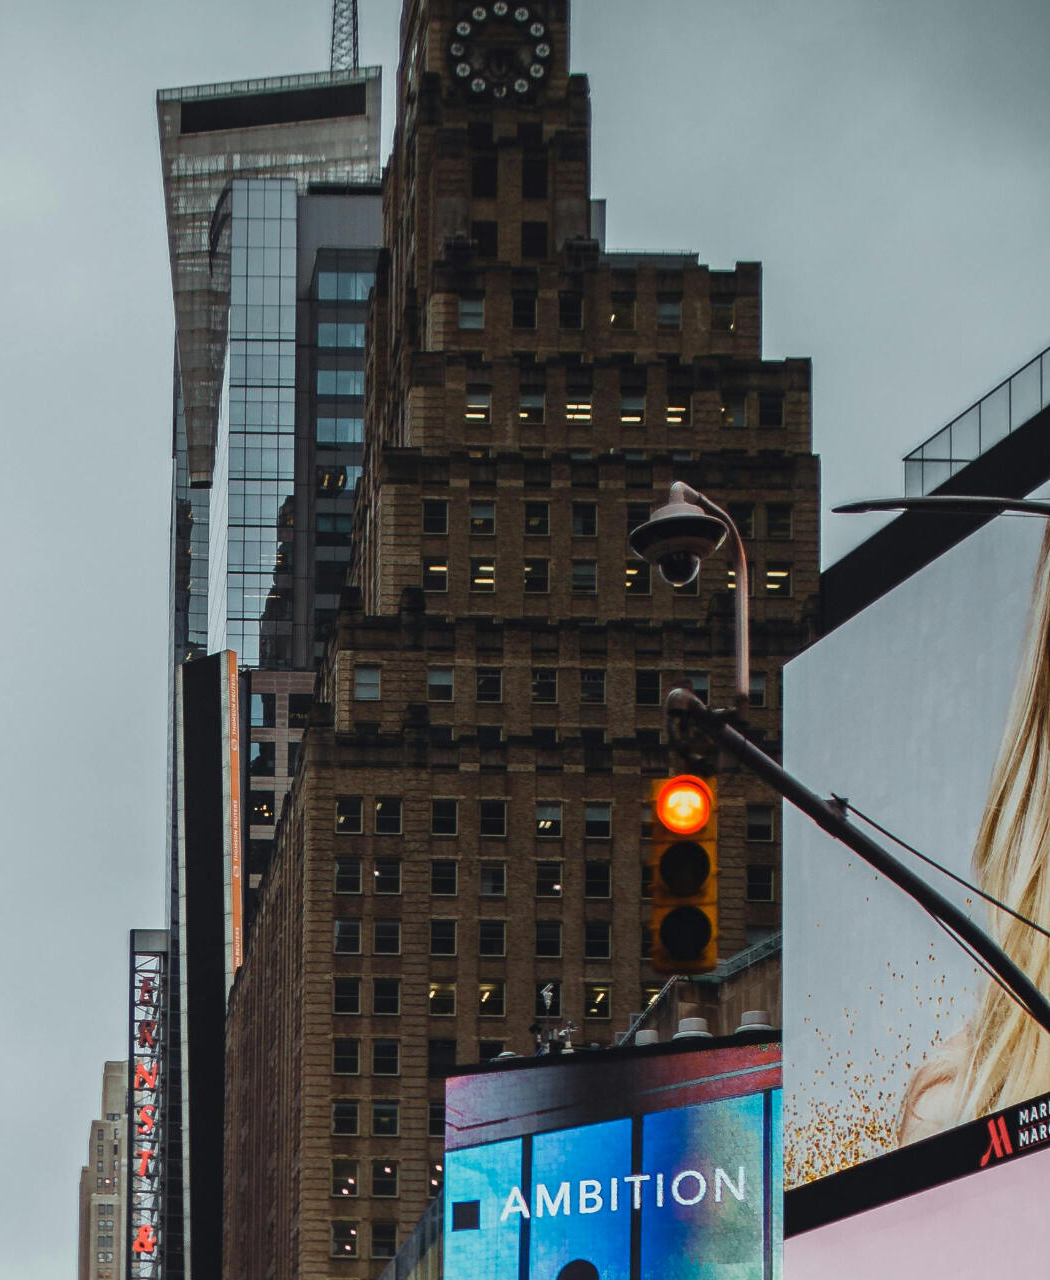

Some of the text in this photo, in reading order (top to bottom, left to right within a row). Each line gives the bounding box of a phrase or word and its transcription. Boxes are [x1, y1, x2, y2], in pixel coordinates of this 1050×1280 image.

[1018, 1100, 1050, 1126] MAR
[1018, 1128, 1050, 1147] MAR
[500, 1165, 748, 1221] AMBITION
[133, 1225, 156, 1253] &
